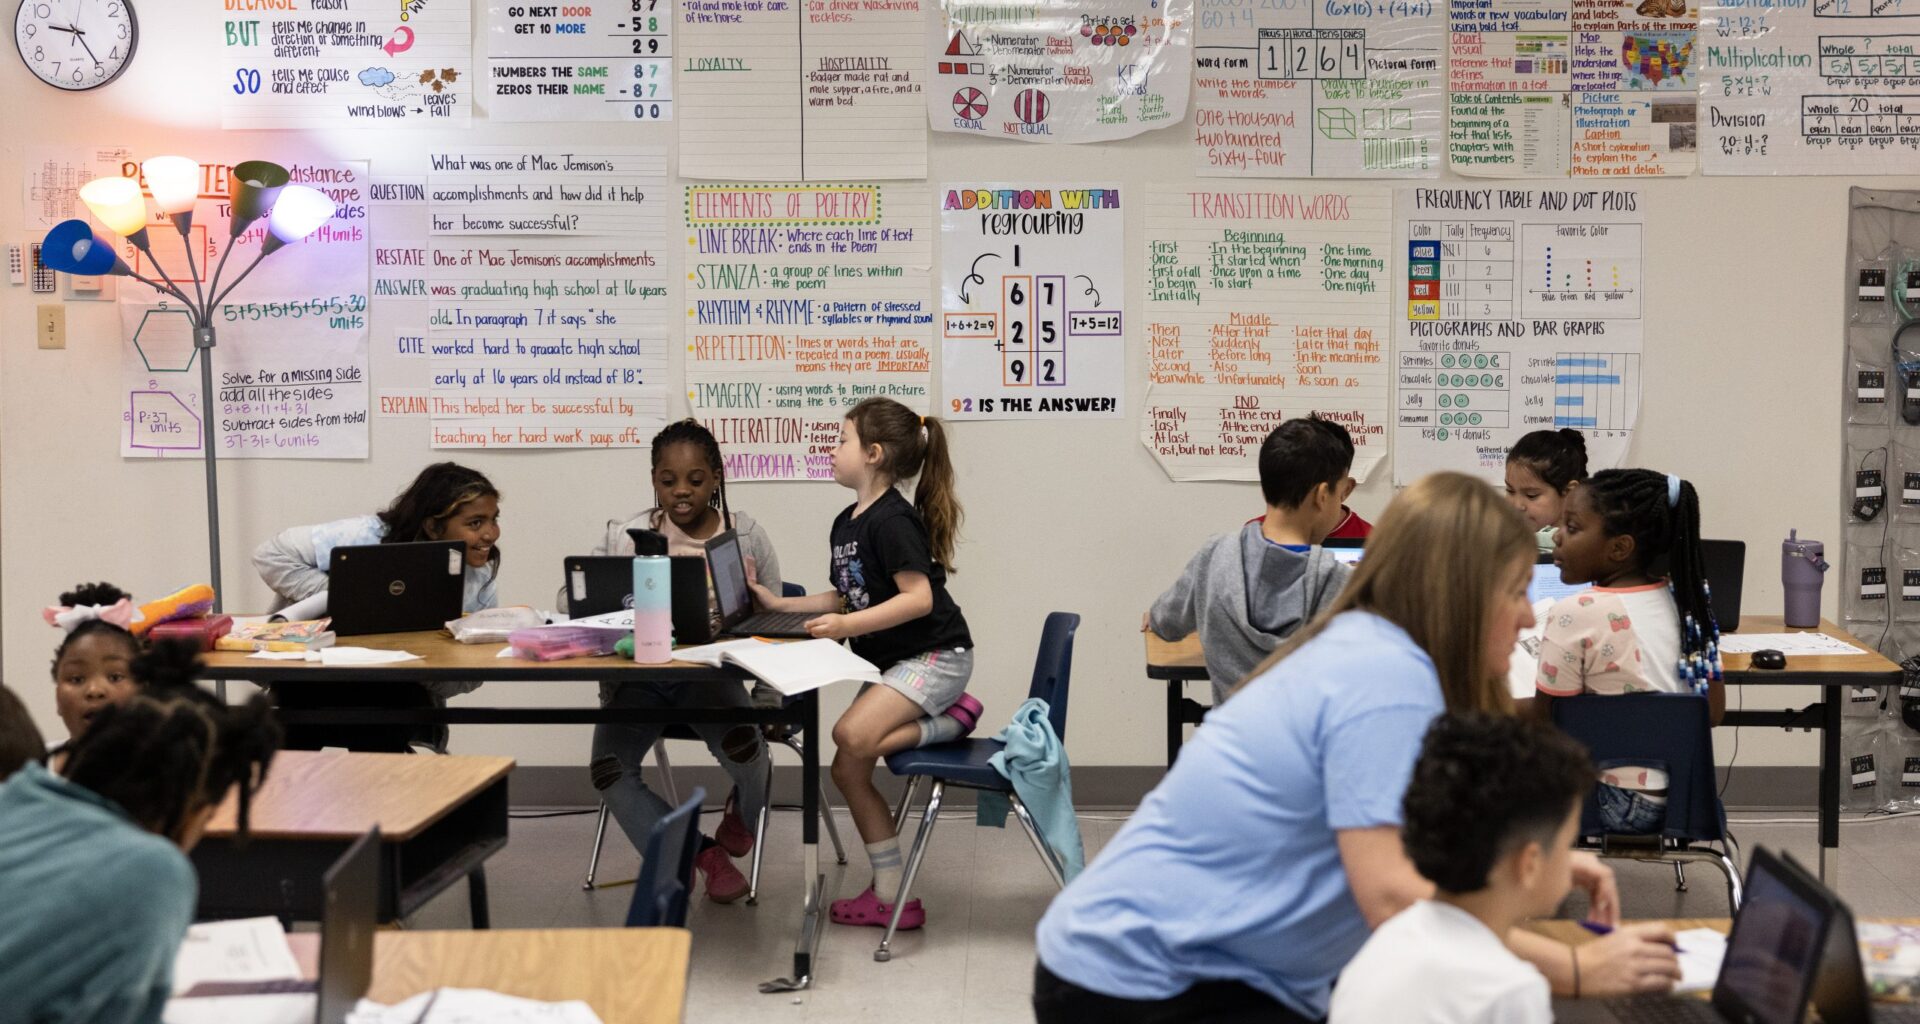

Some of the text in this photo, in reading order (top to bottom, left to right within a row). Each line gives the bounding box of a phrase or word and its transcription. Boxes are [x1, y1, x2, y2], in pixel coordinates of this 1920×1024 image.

[34, 4, 50, 18] 10
[108, 3, 119, 17] 2
[509, 7, 592, 17] GO NEXT DOOR
[26, 24, 36, 39] 9
[117, 24, 126, 39] 3
[225, 21, 260, 46] BUT
[515, 24, 586, 34] GET 10 MORE
[271, 34, 382, 50] direction something
[1580, 34, 1601, 46] Map
[35, 46, 44, 61] 8
[109, 46, 119, 60] 4
[274, 47, 320, 58] different
[1268, 46, 1278, 71] 1
[1295, 46, 1309, 71] 2
[1320, 46, 1336, 72] 6
[1346, 44, 1358, 71] 4
[1575, 46, 1614, 58] Helps the
[1708, 46, 1811, 71] Multiplication
[51, 62, 61, 76] 7
[94, 62, 104, 77] 5
[688, 58, 744, 71] LOYALTY
[819, 57, 889, 70] HOSPITALITY
[1410, 57, 1436, 71] form
[73, 68, 83, 82] 6
[272, 69, 350, 82] tells cause
[493, 67, 608, 77] NUMBERS THE SAME
[810, 71, 909, 84] Badger made and
[1007, 67, 1053, 77] Numerator
[233, 69, 261, 94] SO
[271, 82, 328, 94] and effect
[497, 84, 605, 95] ZEROS THEIR NAME
[424, 94, 457, 106] leaves
[809, 97, 834, 107] warm
[1451, 92, 1472, 103] Table
[1582, 93, 1620, 104] Picture
[430, 105, 451, 117] fall
[1808, 98, 1903, 115] whole 20 total
[954, 118, 985, 131] EQUAL
[1196, 108, 1294, 128] One thousand
[1451, 118, 1491, 131] beginning
[1576, 117, 1631, 129] illustration
[1710, 106, 1765, 128] Division
[1004, 122, 1053, 135] NOT EQUAL
[1584, 130, 1621, 141] Caption
[1810, 125, 1831, 134] each
[1223, 130, 1281, 147] hundred
[431, 154, 614, 173] What was one of Mae Jemison's
[1209, 149, 1287, 170] Sixty-four
[290, 164, 355, 188] distance
[370, 184, 425, 201] QUESTION
[432, 184, 645, 204] accomplishments and how did help
[945, 190, 1120, 210] ADDITION WITH
[1416, 188, 1637, 211] FREQUENCY TABLE AND DOT PLOTS
[697, 191, 872, 219] ELEMENTS OF POETRY
[1188, 193, 1352, 220] TRANSITION WORDS
[433, 214, 580, 231] her become successful?
[981, 210, 1084, 236] regrouping
[1224, 229, 1285, 246] Beginning
[1446, 225, 1465, 239] Tally
[1470, 225, 1511, 241] Frequency
[699, 228, 729, 254] LINE
[375, 250, 426, 267] RESTATE
[697, 263, 761, 290] STANZA
[374, 280, 428, 296] ANSWER
[461, 279, 601, 299] graduating high school
[796, 279, 826, 291] poem
[698, 300, 815, 325] RHYTHM RHYME
[1230, 313, 1272, 326] Middle
[330, 316, 364, 329] units
[1072, 317, 1119, 330] 7+5=12
[1410, 321, 1604, 338] PICTOGRAPHS AND BAR GRAPHS
[399, 337, 427, 355] CITE
[432, 338, 510, 355] worked hard
[695, 335, 786, 361] REPETITION
[876, 360, 930, 372] IMPORTANT
[694, 383, 762, 409] IMAGERY
[1233, 396, 1259, 408] END
[382, 396, 429, 415] EXPLAIN
[433, 396, 501, 417] This helped
[952, 398, 1116, 413] 92 IS THE ANSWER!
[222, 409, 367, 432] Subtract sides from total
[435, 427, 548, 447] teaching her hard
